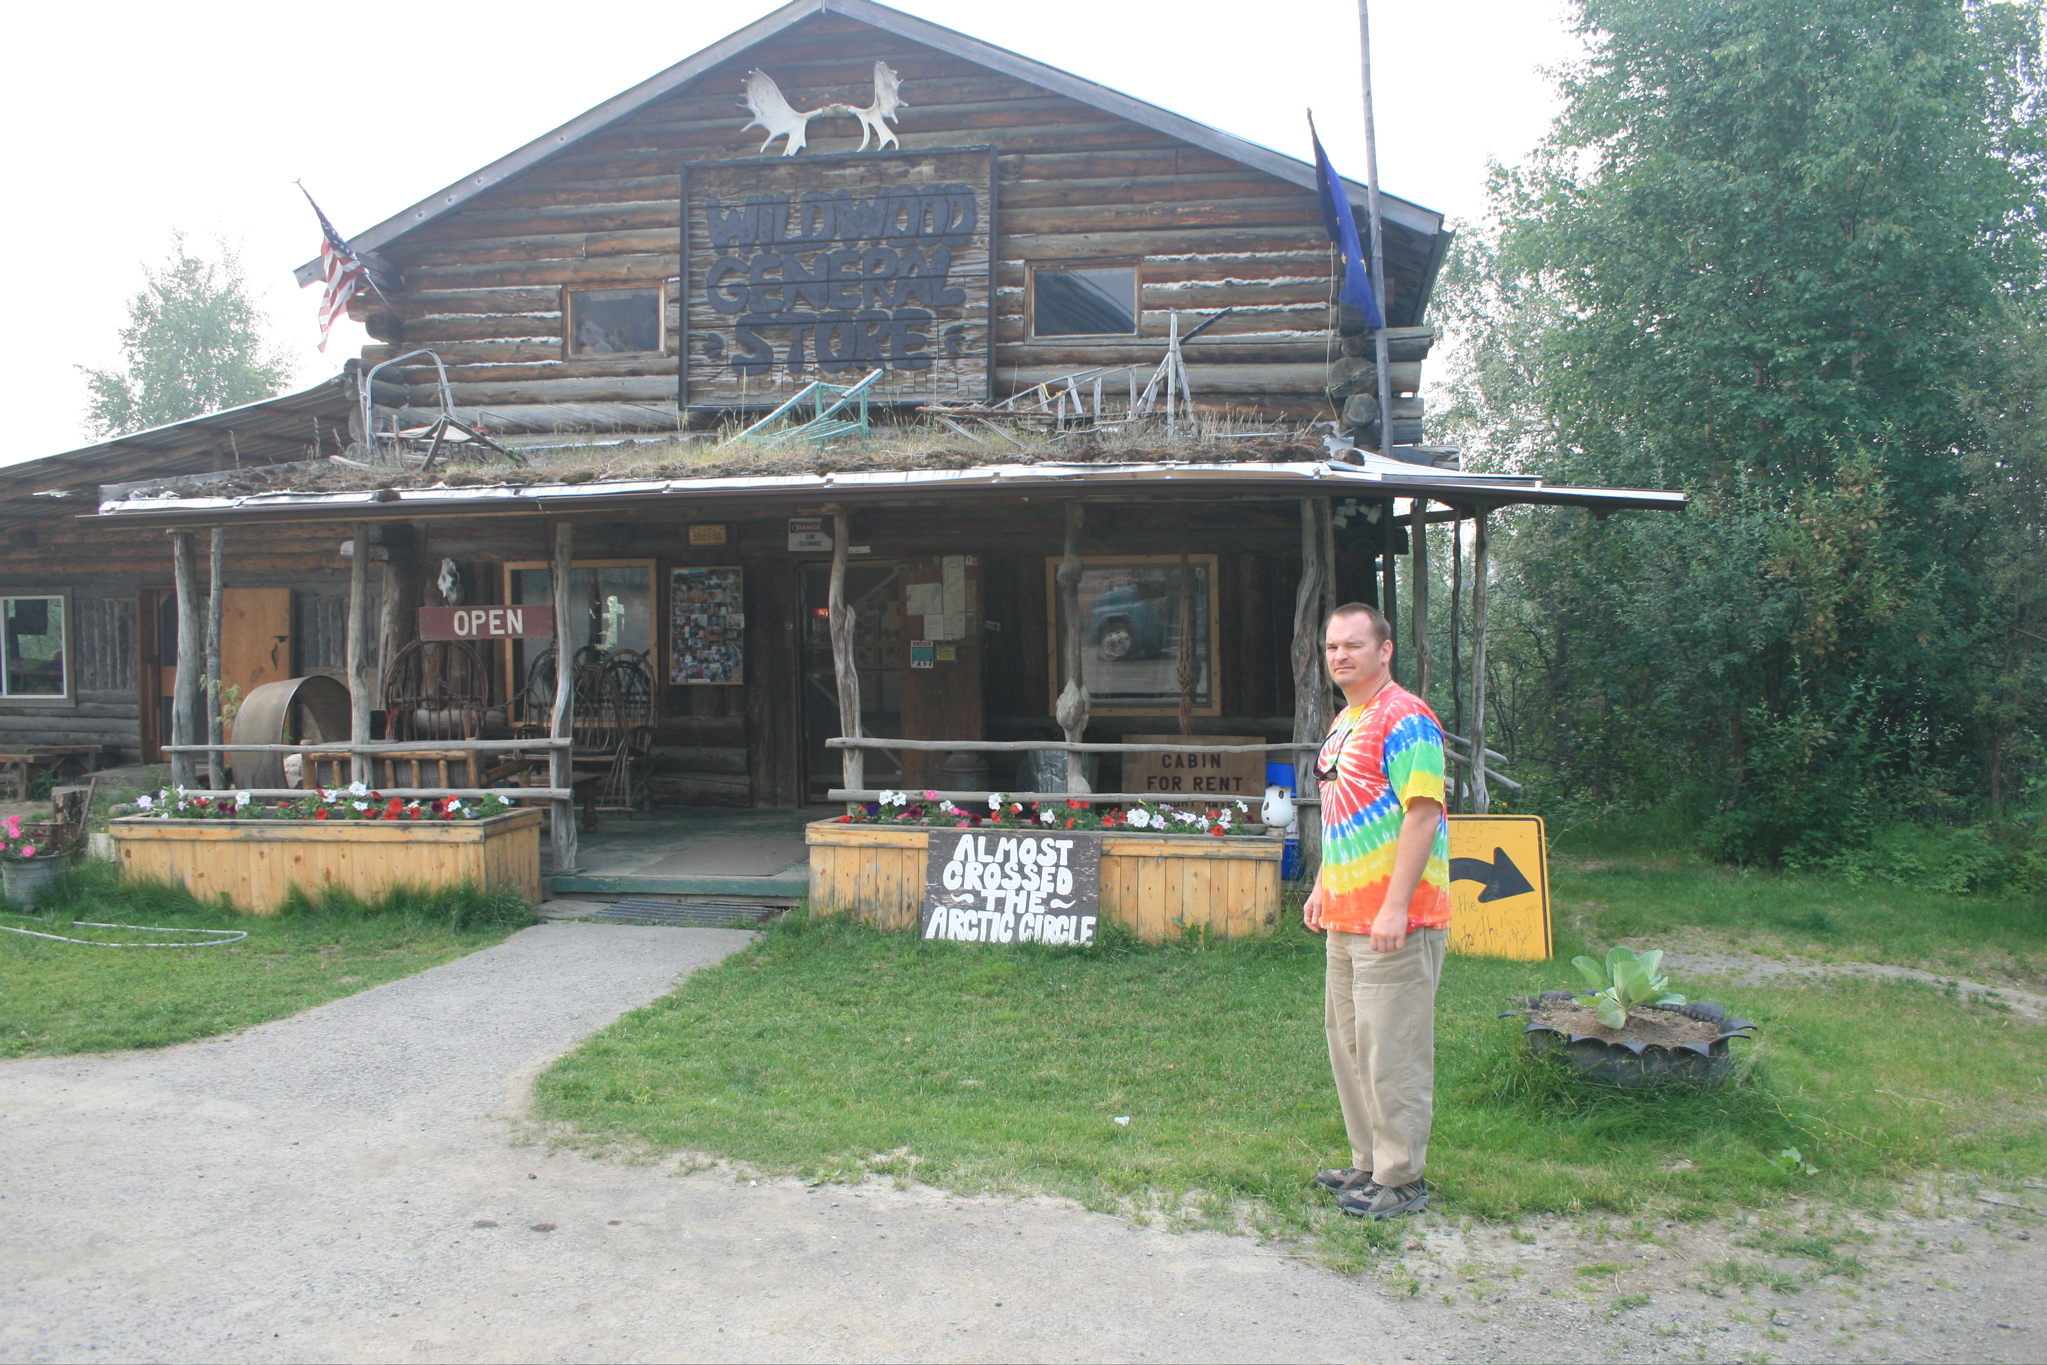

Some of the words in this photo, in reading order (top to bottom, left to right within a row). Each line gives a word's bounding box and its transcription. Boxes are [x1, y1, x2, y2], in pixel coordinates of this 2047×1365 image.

[706, 183, 978, 255] WILDWOOD
[706, 246, 967, 315] GENERAL
[731, 308, 933, 375] STORE
[453, 608, 524, 636] OPEN
[1161, 753, 1222, 768] CABIN
[1147, 775, 1182, 791] FOR
[1193, 776, 1244, 791] RENT
[953, 833, 1074, 867] ALMOST
[942, 860, 1073, 896] CROSSED
[980, 889, 1048, 914] THE
[925, 906, 1015, 944] ARCTIC
[1018, 913, 1097, 948] CIRCLE
